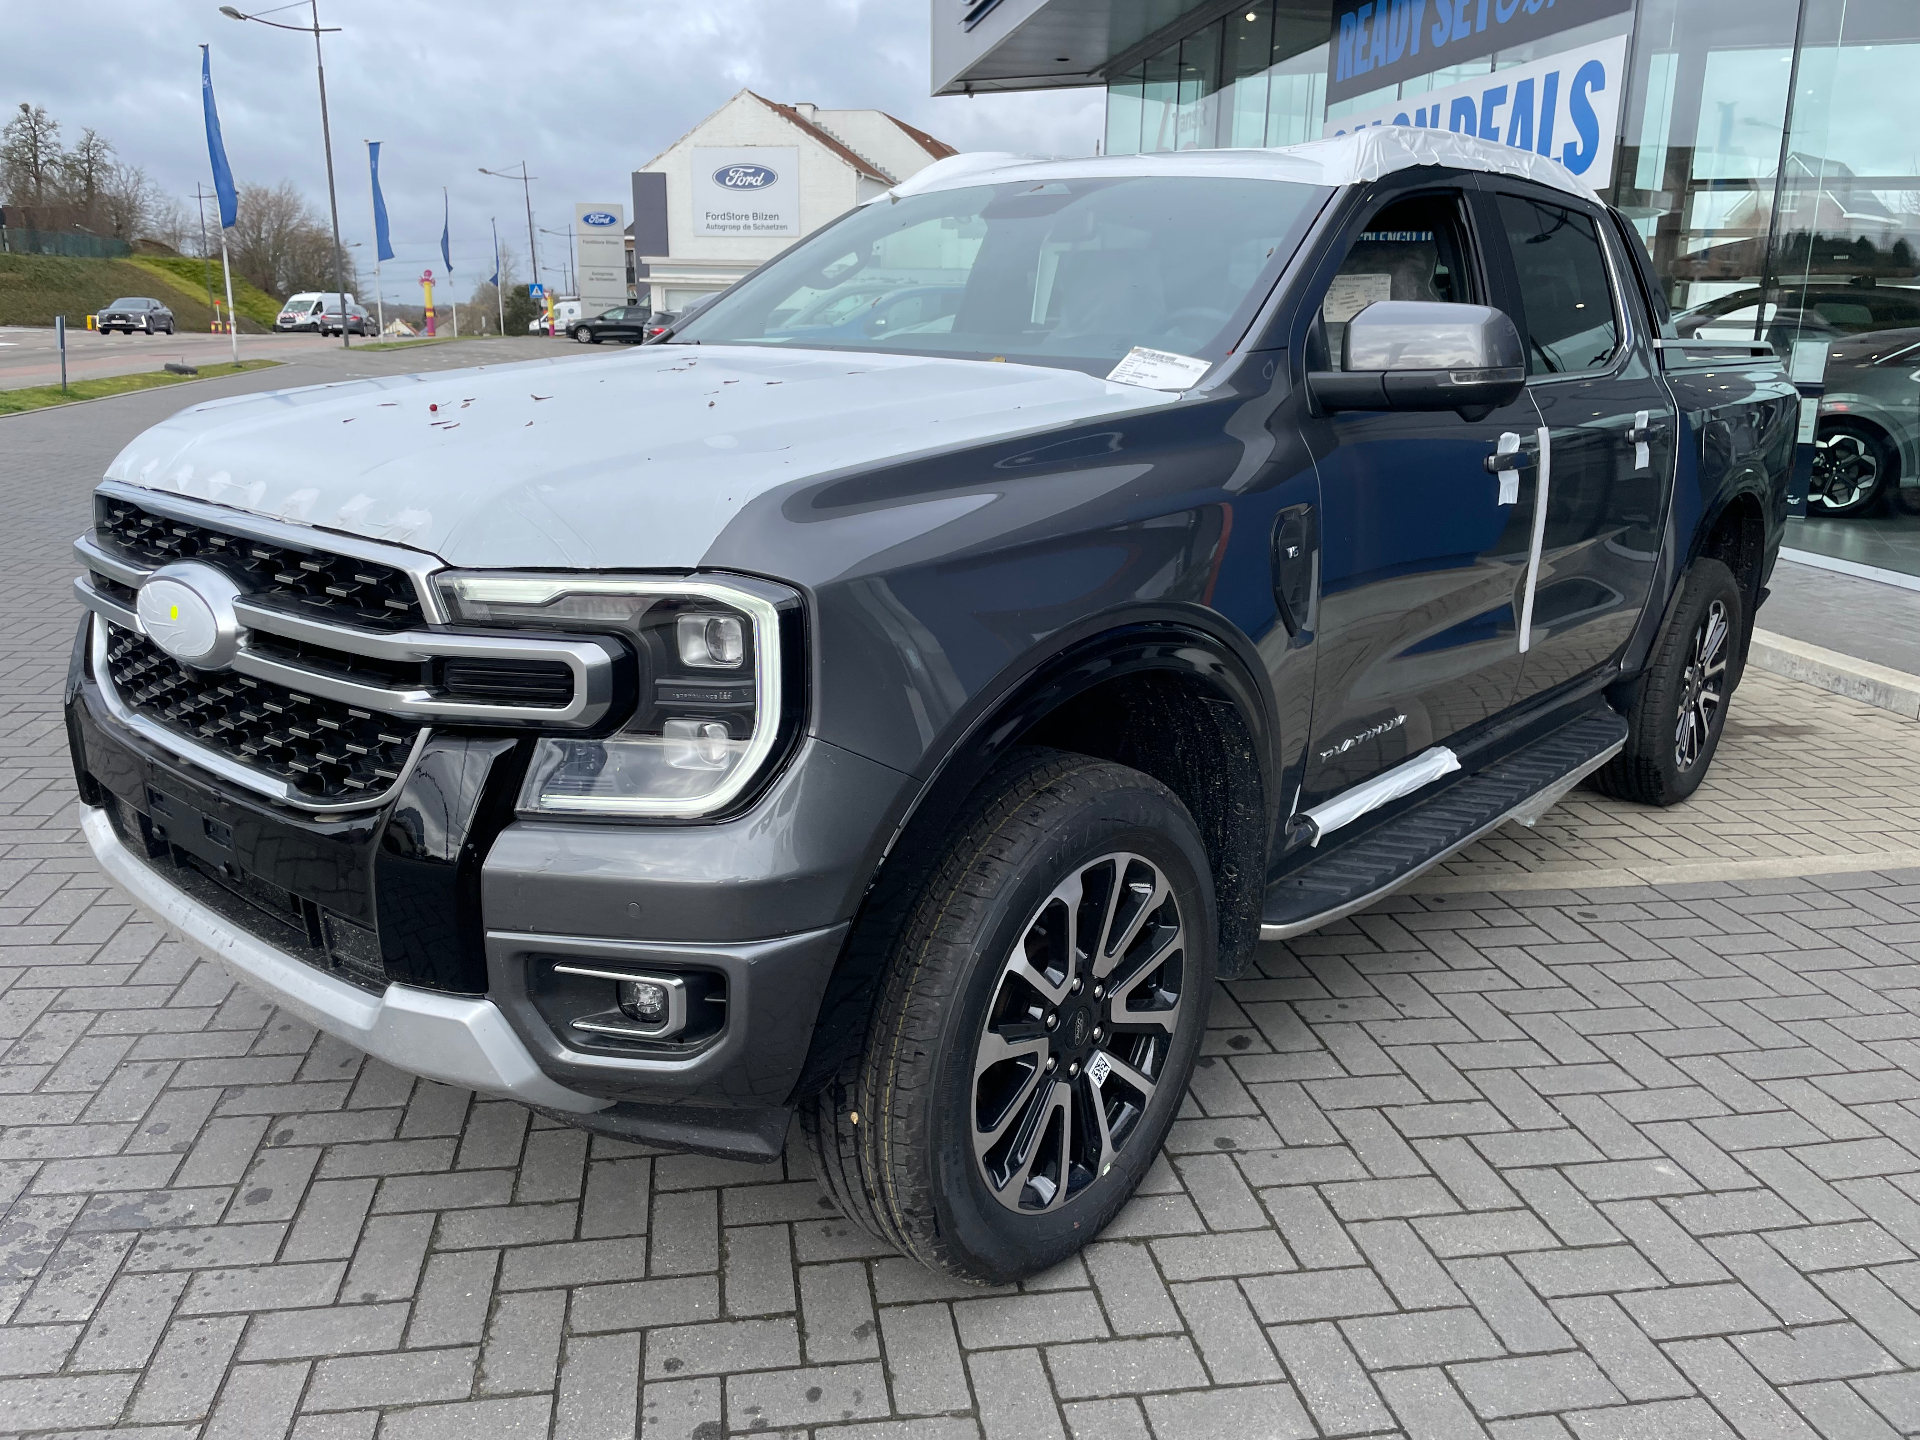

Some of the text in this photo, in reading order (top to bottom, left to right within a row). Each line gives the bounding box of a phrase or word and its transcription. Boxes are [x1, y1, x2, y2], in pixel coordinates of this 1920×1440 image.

[1336, 0, 1427, 82] READY
[725, 167, 765, 186] Ford
[588, 213, 610, 224] Ford
[705, 212, 780, 221] FordStore Bilzen
[705, 223, 788, 232] Autogroep de Schaetzen
